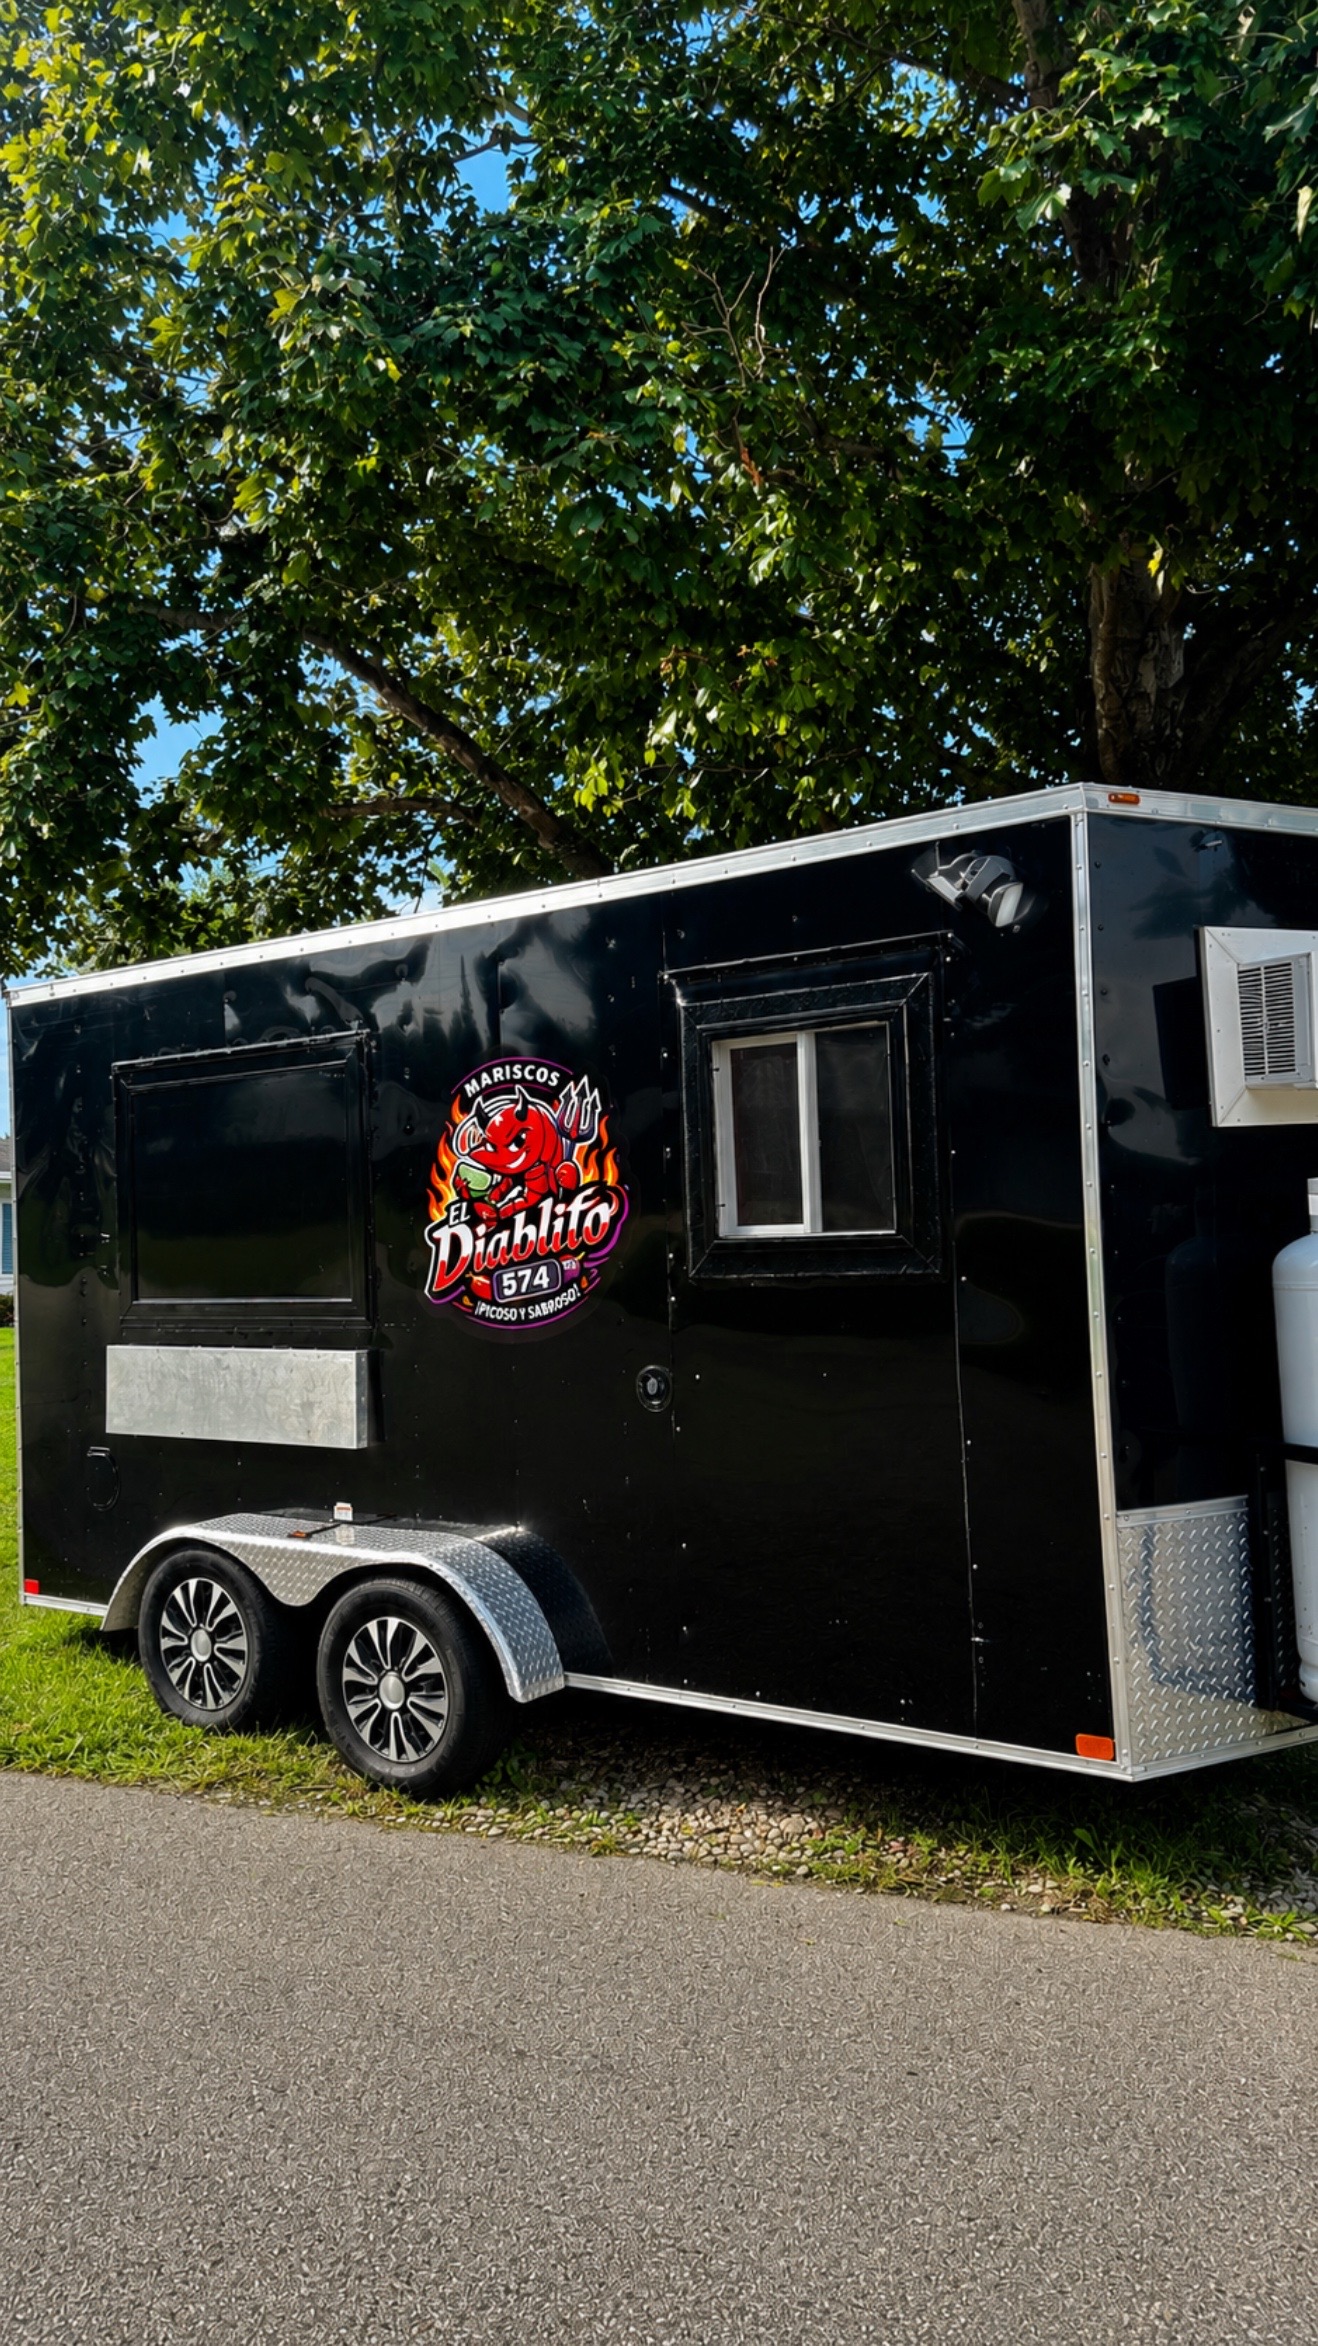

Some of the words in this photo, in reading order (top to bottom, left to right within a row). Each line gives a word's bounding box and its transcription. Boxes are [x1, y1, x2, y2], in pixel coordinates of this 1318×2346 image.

[464, 1064, 560, 1098] MARISCOS
[450, 1202, 470, 1225] EL
[502, 1265, 550, 1297] 574
[519, 1307, 526, 1320] Y
